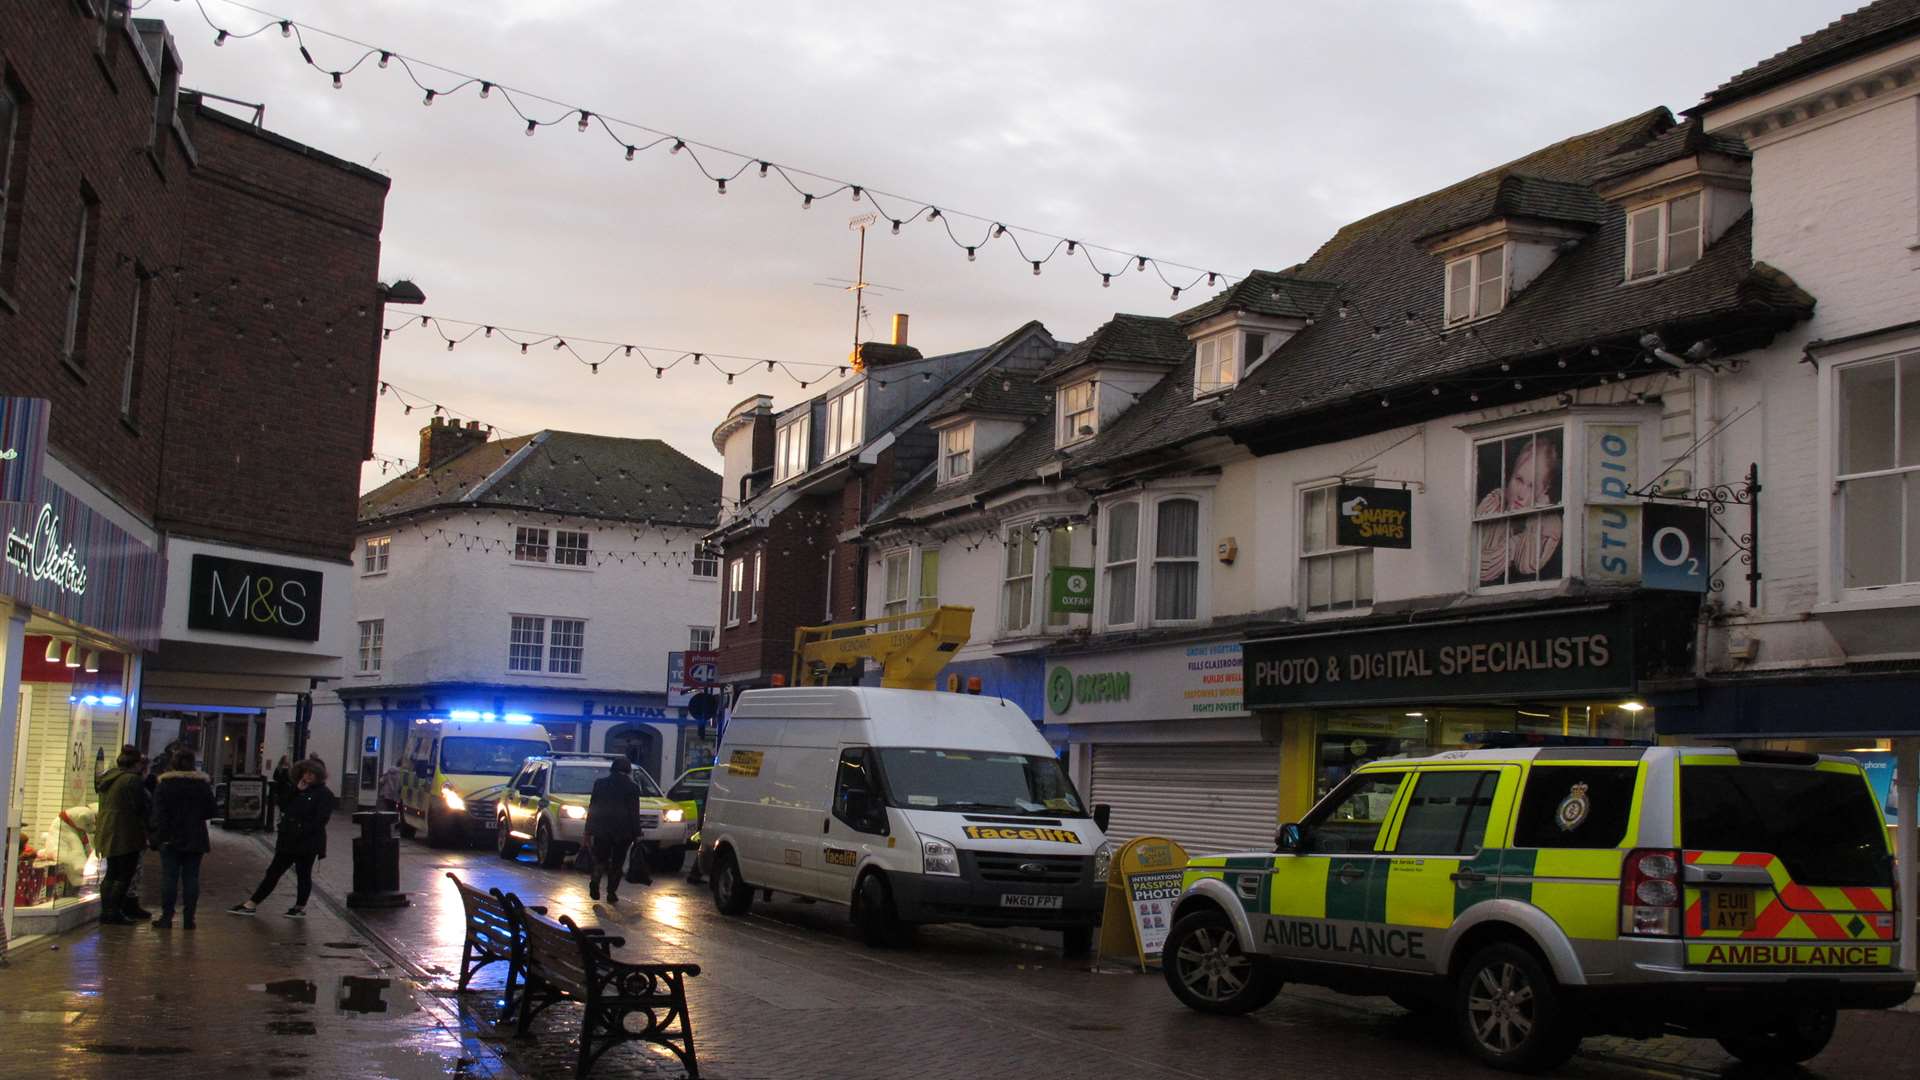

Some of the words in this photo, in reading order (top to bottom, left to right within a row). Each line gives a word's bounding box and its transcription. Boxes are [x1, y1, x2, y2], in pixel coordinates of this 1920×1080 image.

[1601, 433, 1627, 575] STUDIO
[1350, 505, 1408, 525] SNAPPY
[1359, 522, 1404, 539] SNAPS
[31, 503, 87, 596] Clintons
[210, 569, 306, 627] M&S
[1204, 658, 1243, 669] CLASSROOM
[1255, 657, 1320, 687] PHOTO
[1326, 655, 1341, 683] &
[1349, 649, 1433, 681] DIGITAL
[1439, 633, 1609, 677] SPECIALISTS
[1075, 671, 1132, 704] OXFAM
[603, 703, 665, 720] HALIFAX
[1864, 760, 1887, 769] phone
[966, 825, 1079, 844] facelift
[824, 848, 856, 867] facelift
[1131, 872, 1184, 882] INTERNATIONA
[1132, 879, 1182, 890] PASSPOR
[1263, 918, 1426, 960] AMBULANCE
[1706, 945, 1878, 965] AMBULANCE
